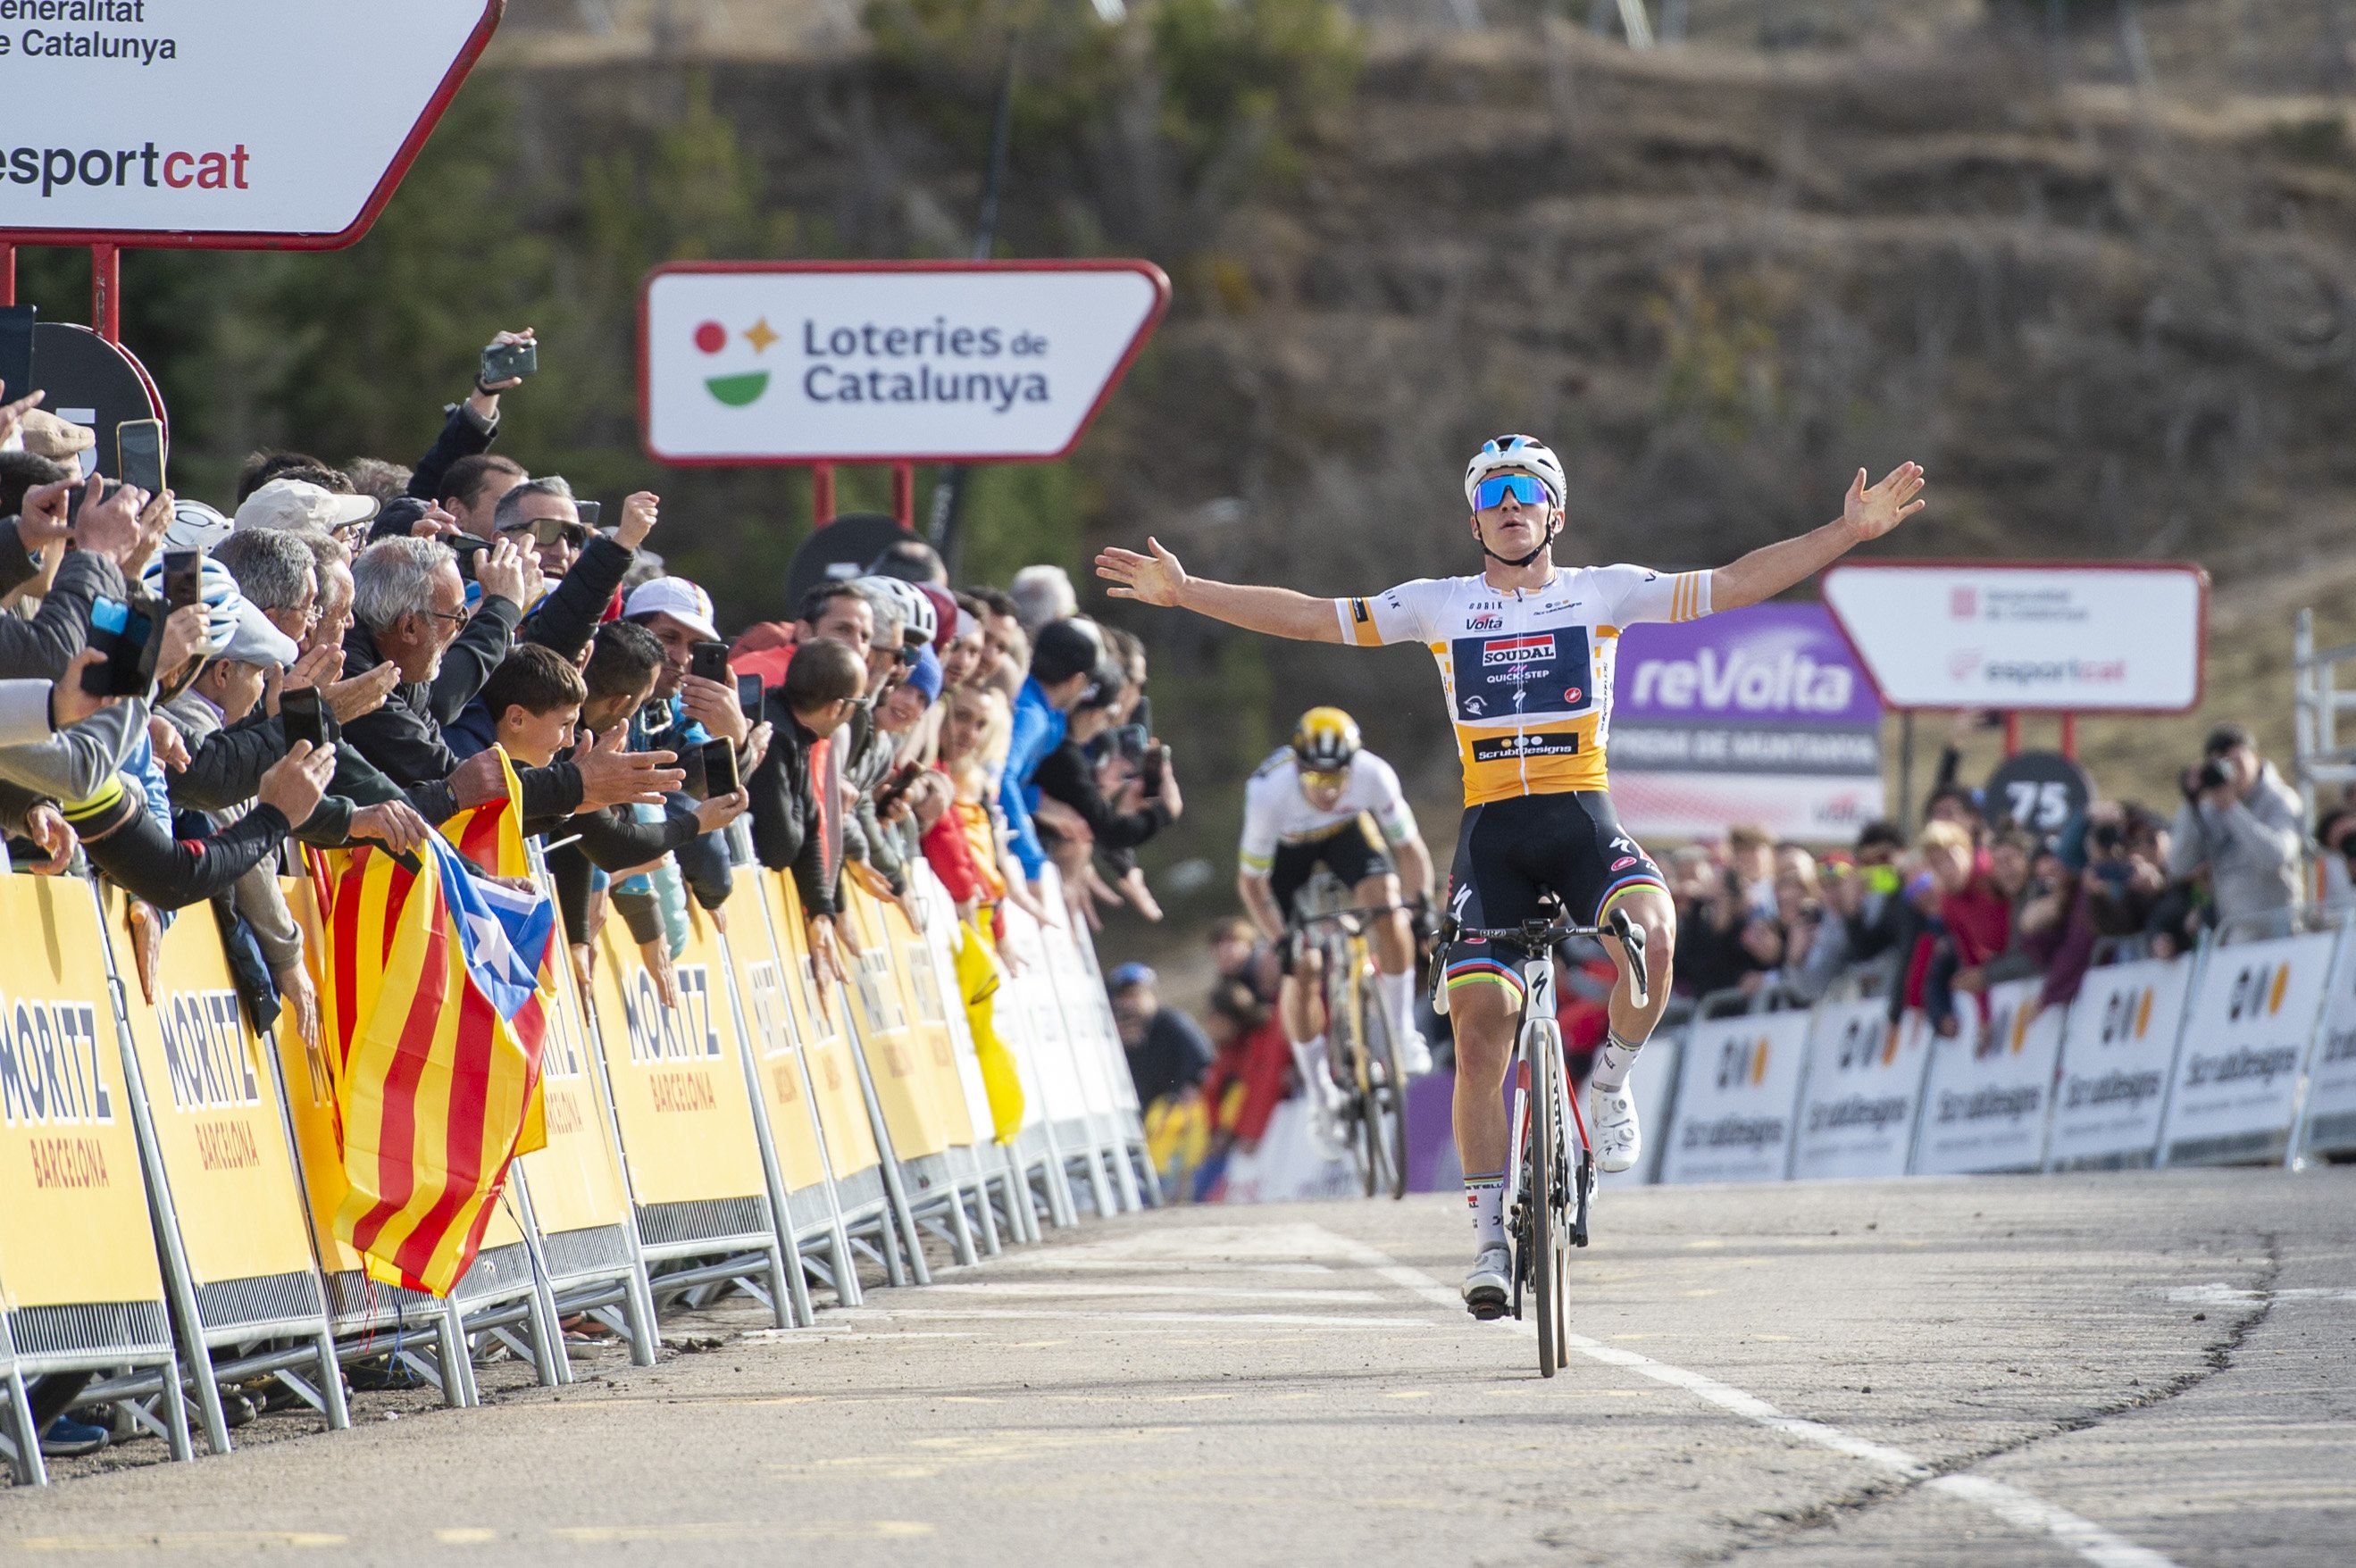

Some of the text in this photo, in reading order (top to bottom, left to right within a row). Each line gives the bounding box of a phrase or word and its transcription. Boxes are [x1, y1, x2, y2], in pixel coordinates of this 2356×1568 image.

[0, 0, 145, 22] eneralitat
[0, 29, 176, 66] e Catalunya
[0, 141, 250, 197] sportcat
[804, 318, 1049, 357] Loteries de
[805, 364, 1050, 413] Catalunya
[1466, 616, 1502, 630] Volta
[1484, 646, 1554, 664] SOUDAL
[1631, 647, 1853, 713] reVolta
[2006, 780, 2069, 827] 75
[0, 997, 113, 1125] MORITZ
[155, 988, 260, 1110] MORITZ
[649, 1071, 716, 1113] BARCELONA
[30, 1138, 110, 1189] BARCELONA
[195, 1120, 261, 1171] BARCELONA
